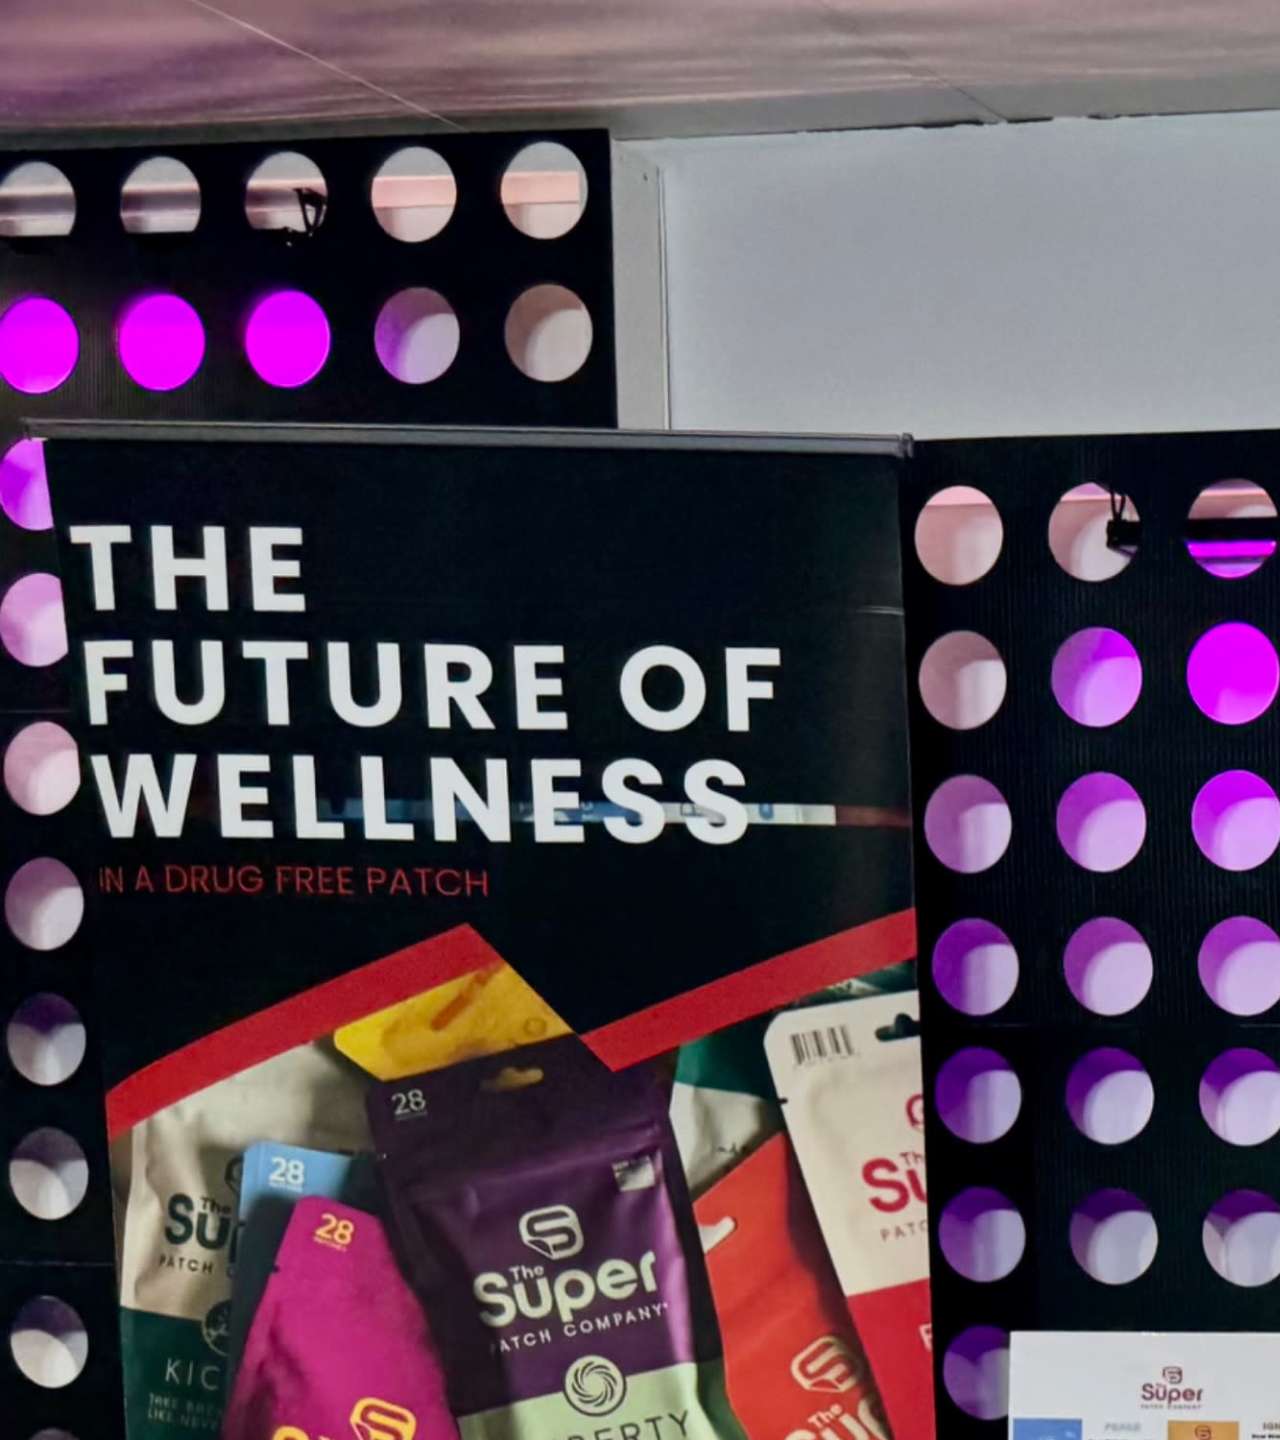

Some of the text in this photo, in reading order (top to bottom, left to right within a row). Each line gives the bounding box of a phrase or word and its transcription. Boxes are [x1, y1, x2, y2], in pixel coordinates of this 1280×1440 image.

[70, 525, 306, 612] THE
[83, 639, 782, 732] FUTURE OF
[90, 753, 749, 845] WELLNESS
[99, 865, 489, 897] IN A DRUG FREE PATCH
[392, 1089, 426, 1116] 28
[268, 1156, 305, 1184] 28
[315, 1214, 355, 1244] 28
[472, 1251, 659, 1328] Super
[509, 1265, 545, 1283] The
